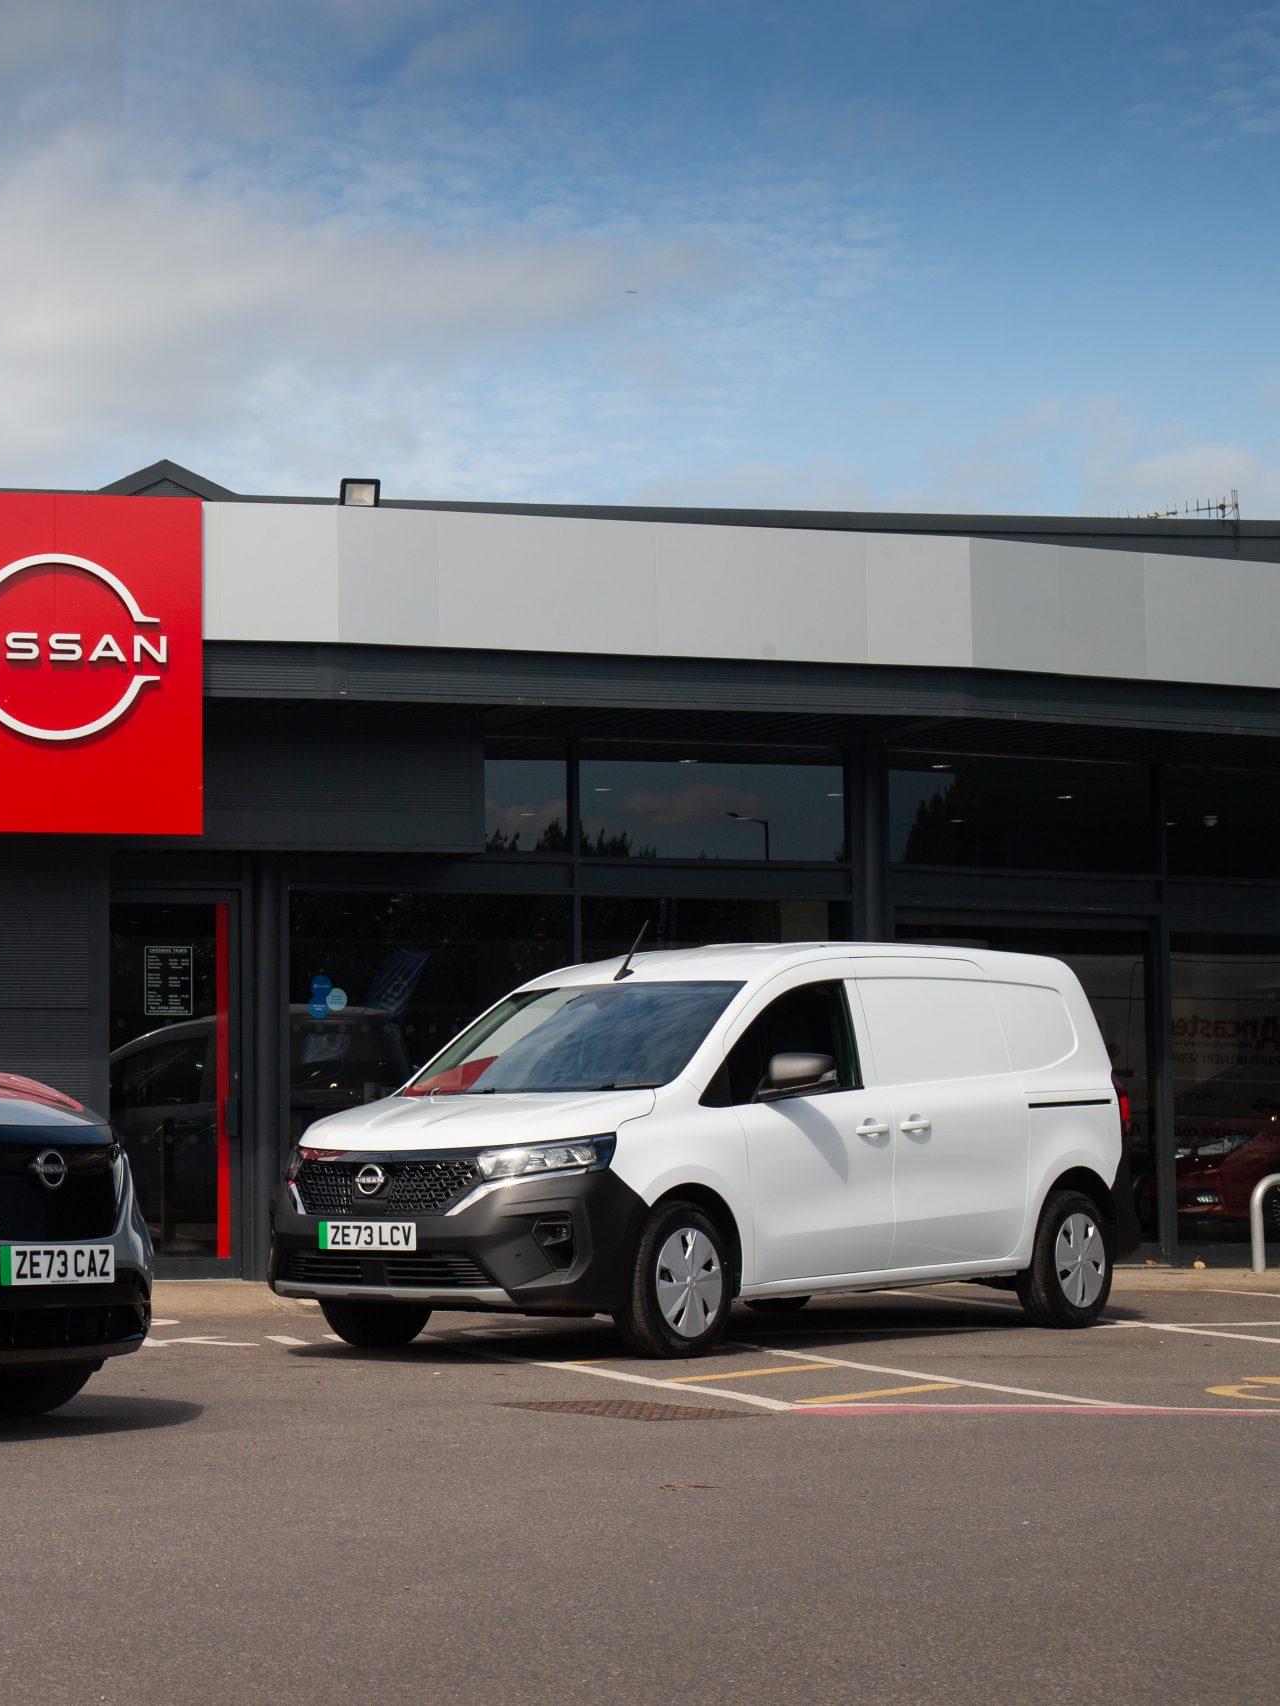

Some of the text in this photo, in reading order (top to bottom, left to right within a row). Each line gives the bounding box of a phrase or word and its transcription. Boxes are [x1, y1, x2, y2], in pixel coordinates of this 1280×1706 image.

[355, 1176, 385, 1184] NISSAN
[330, 1225, 412, 1246] ZE73 LCV
[15, 1249, 110, 1279] ZE73 CAZ
